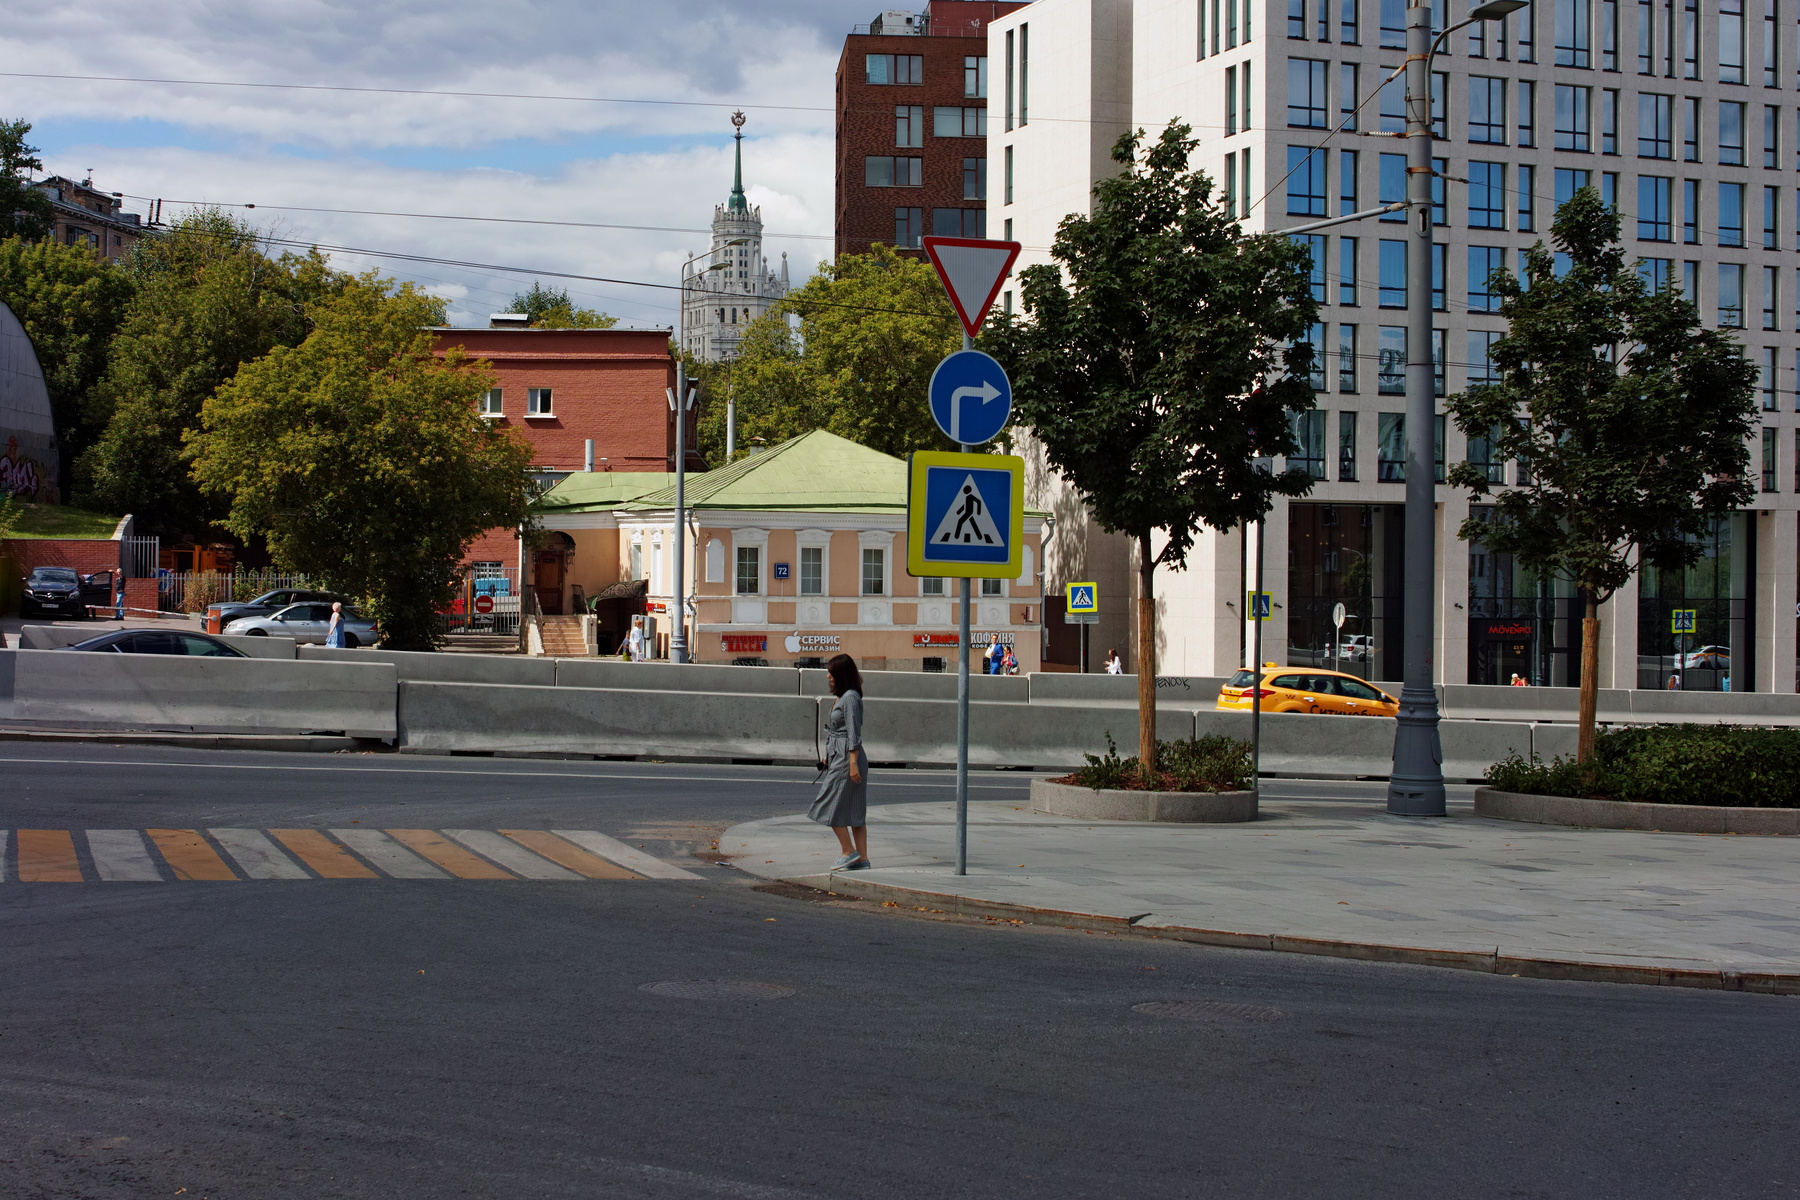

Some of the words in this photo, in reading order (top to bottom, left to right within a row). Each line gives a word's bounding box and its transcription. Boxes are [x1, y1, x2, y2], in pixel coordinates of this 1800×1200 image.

[777, 567, 787, 575] 72
[801, 635, 840, 644] СЕРВИС
[913, 634, 960, 643] КОПИР
[1310, 705, 1384, 716] Ситимоб
